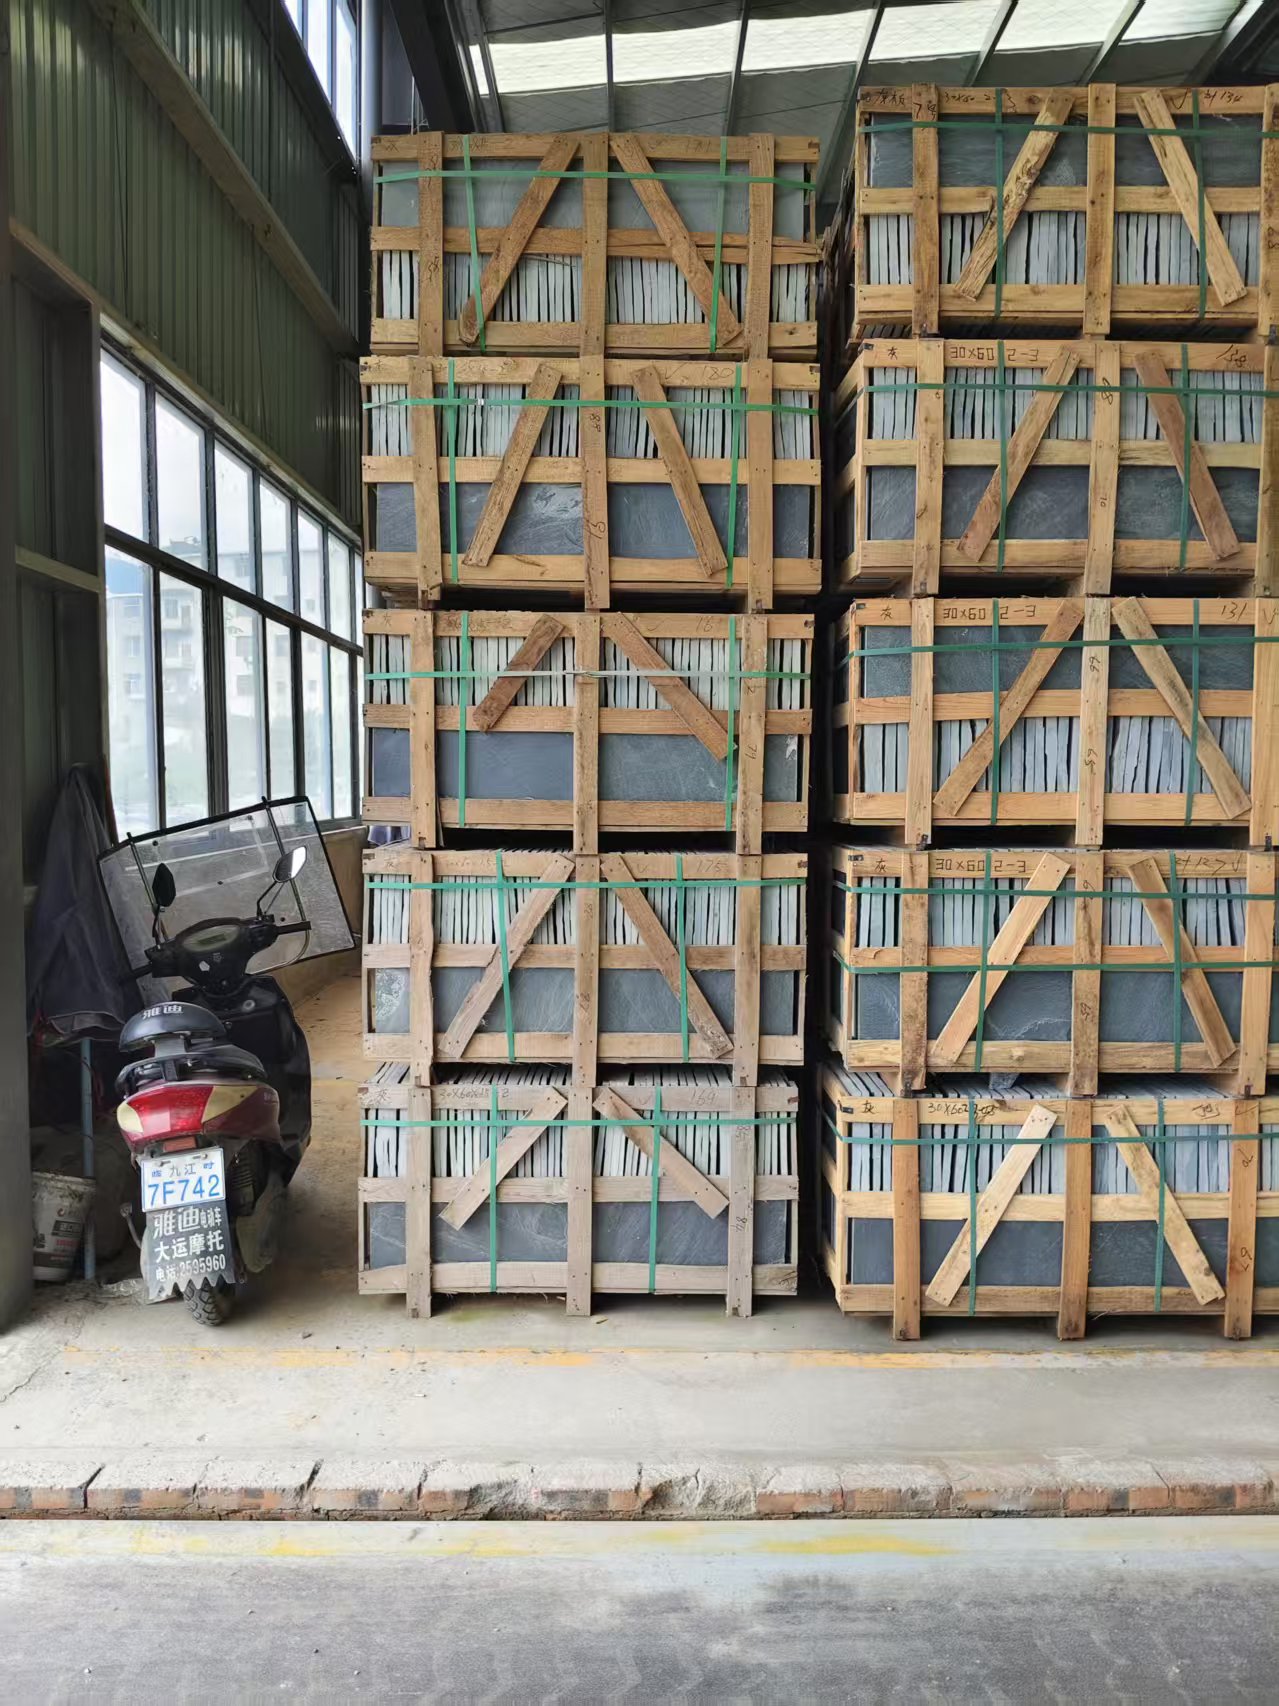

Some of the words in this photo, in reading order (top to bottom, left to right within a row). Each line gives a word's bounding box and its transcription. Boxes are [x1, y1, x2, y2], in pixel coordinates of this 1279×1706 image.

[169, 1163, 196, 1178] 九江
[147, 1174, 220, 1207] 7F742
[154, 1229, 224, 1264] 大运摩托
